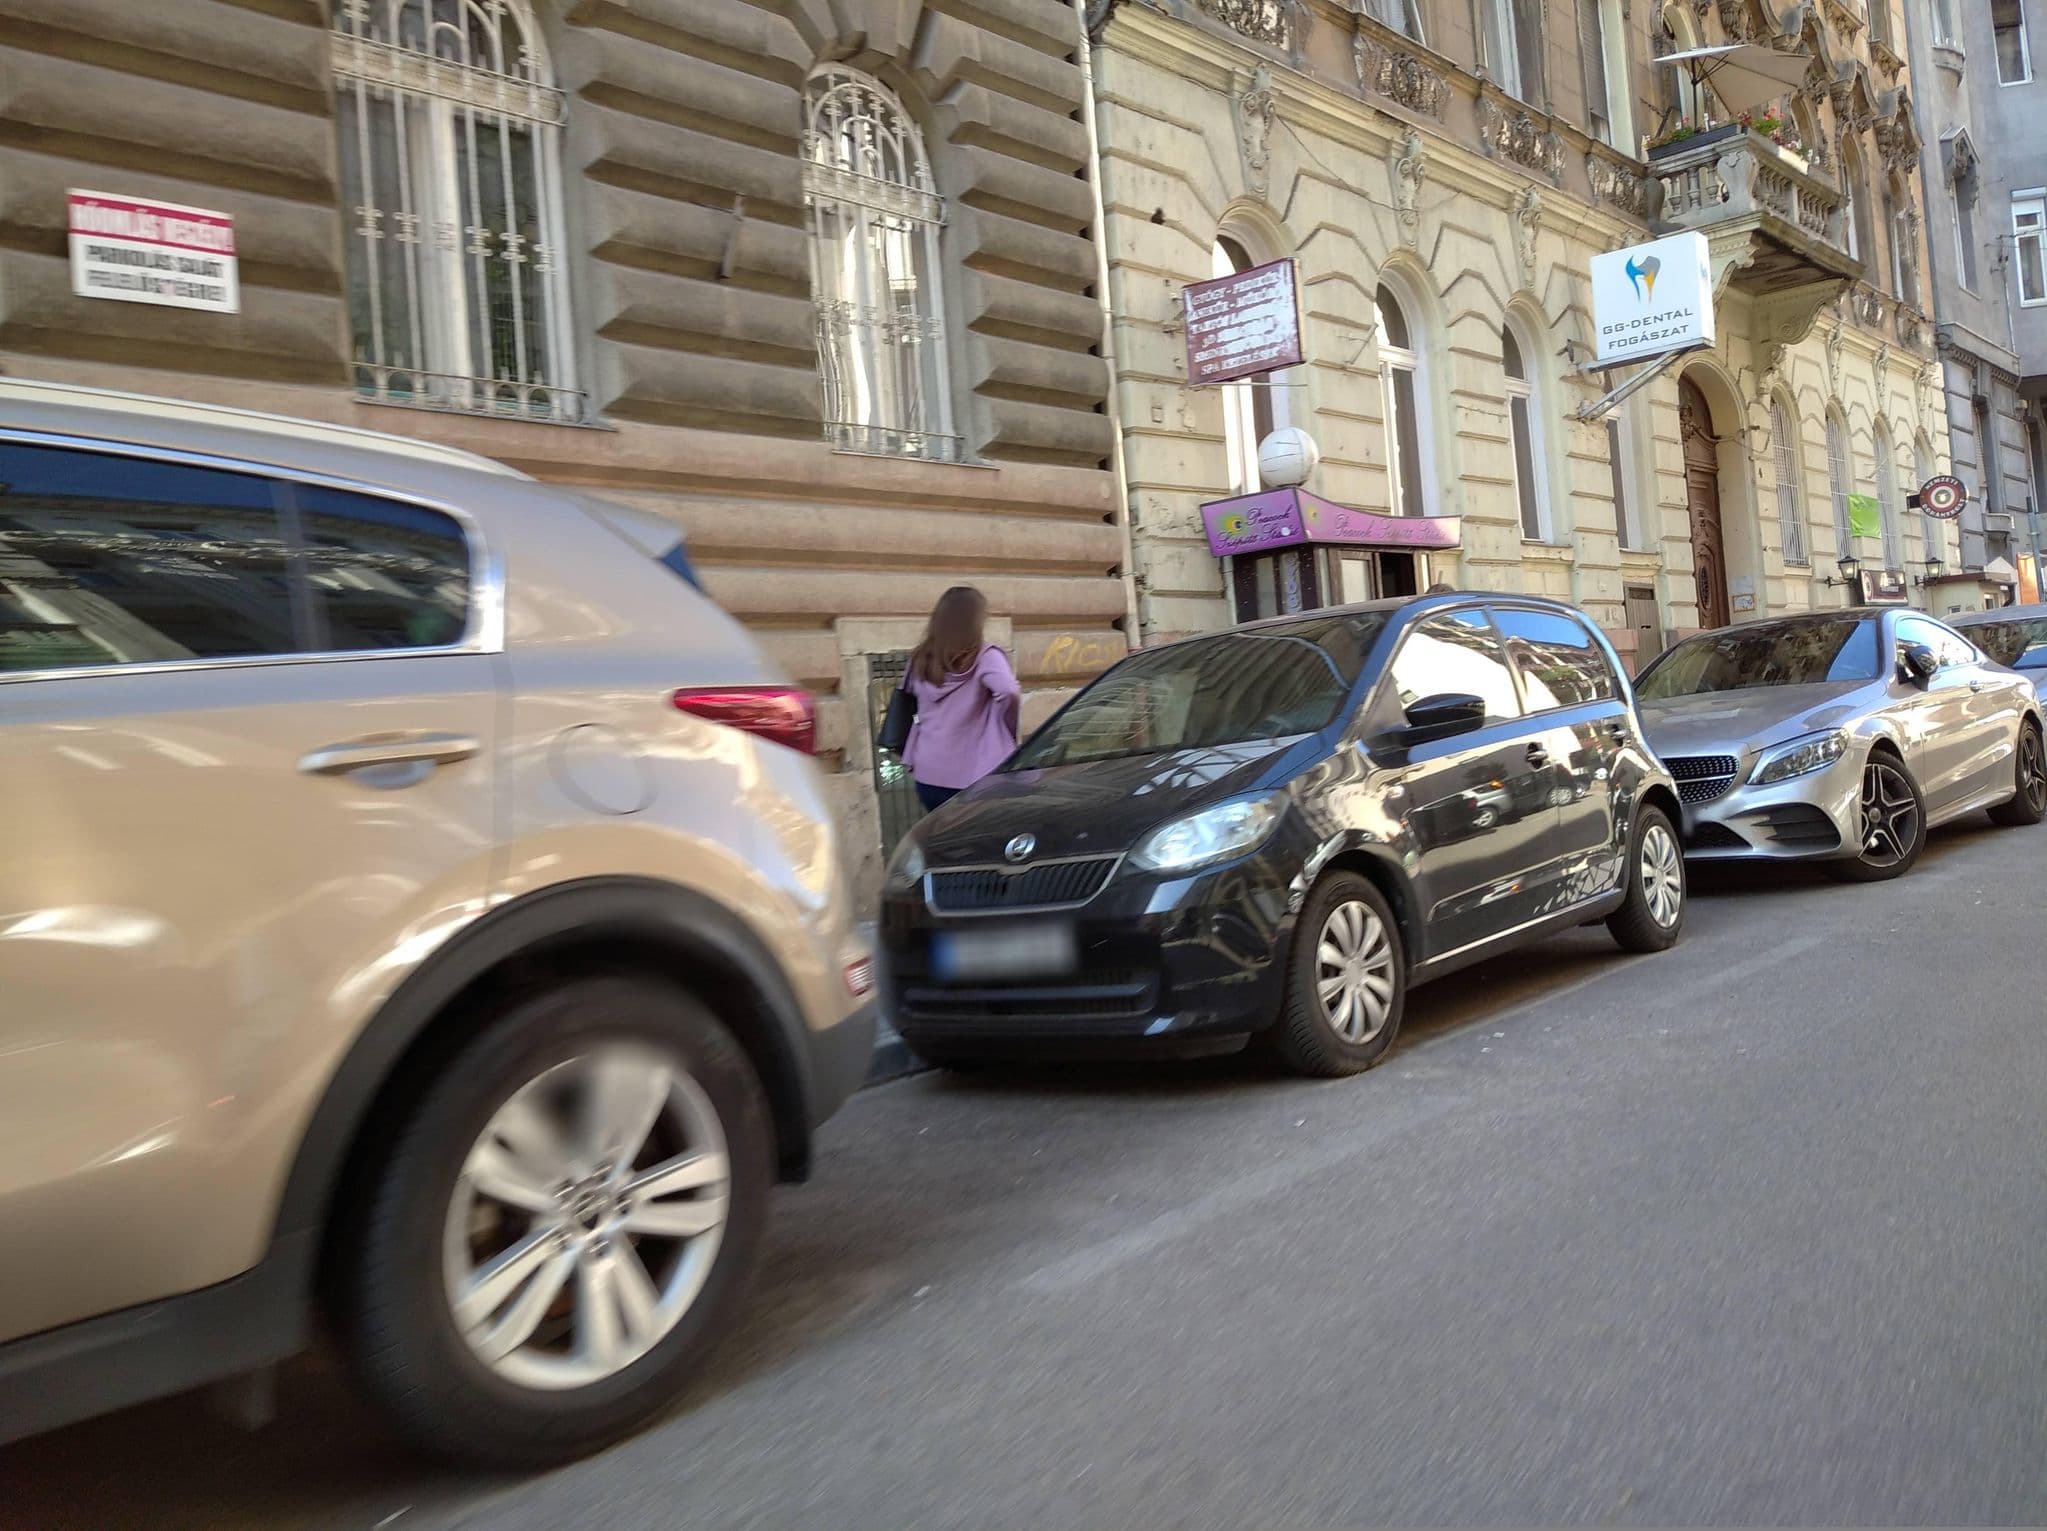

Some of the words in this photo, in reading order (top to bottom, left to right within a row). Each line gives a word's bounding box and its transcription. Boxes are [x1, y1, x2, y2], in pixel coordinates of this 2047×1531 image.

[1602, 307, 1694, 335] GG-DENTAL
[1608, 323, 1689, 350] FOGÁSZAT
[1925, 477, 1959, 490] NEMZETI
